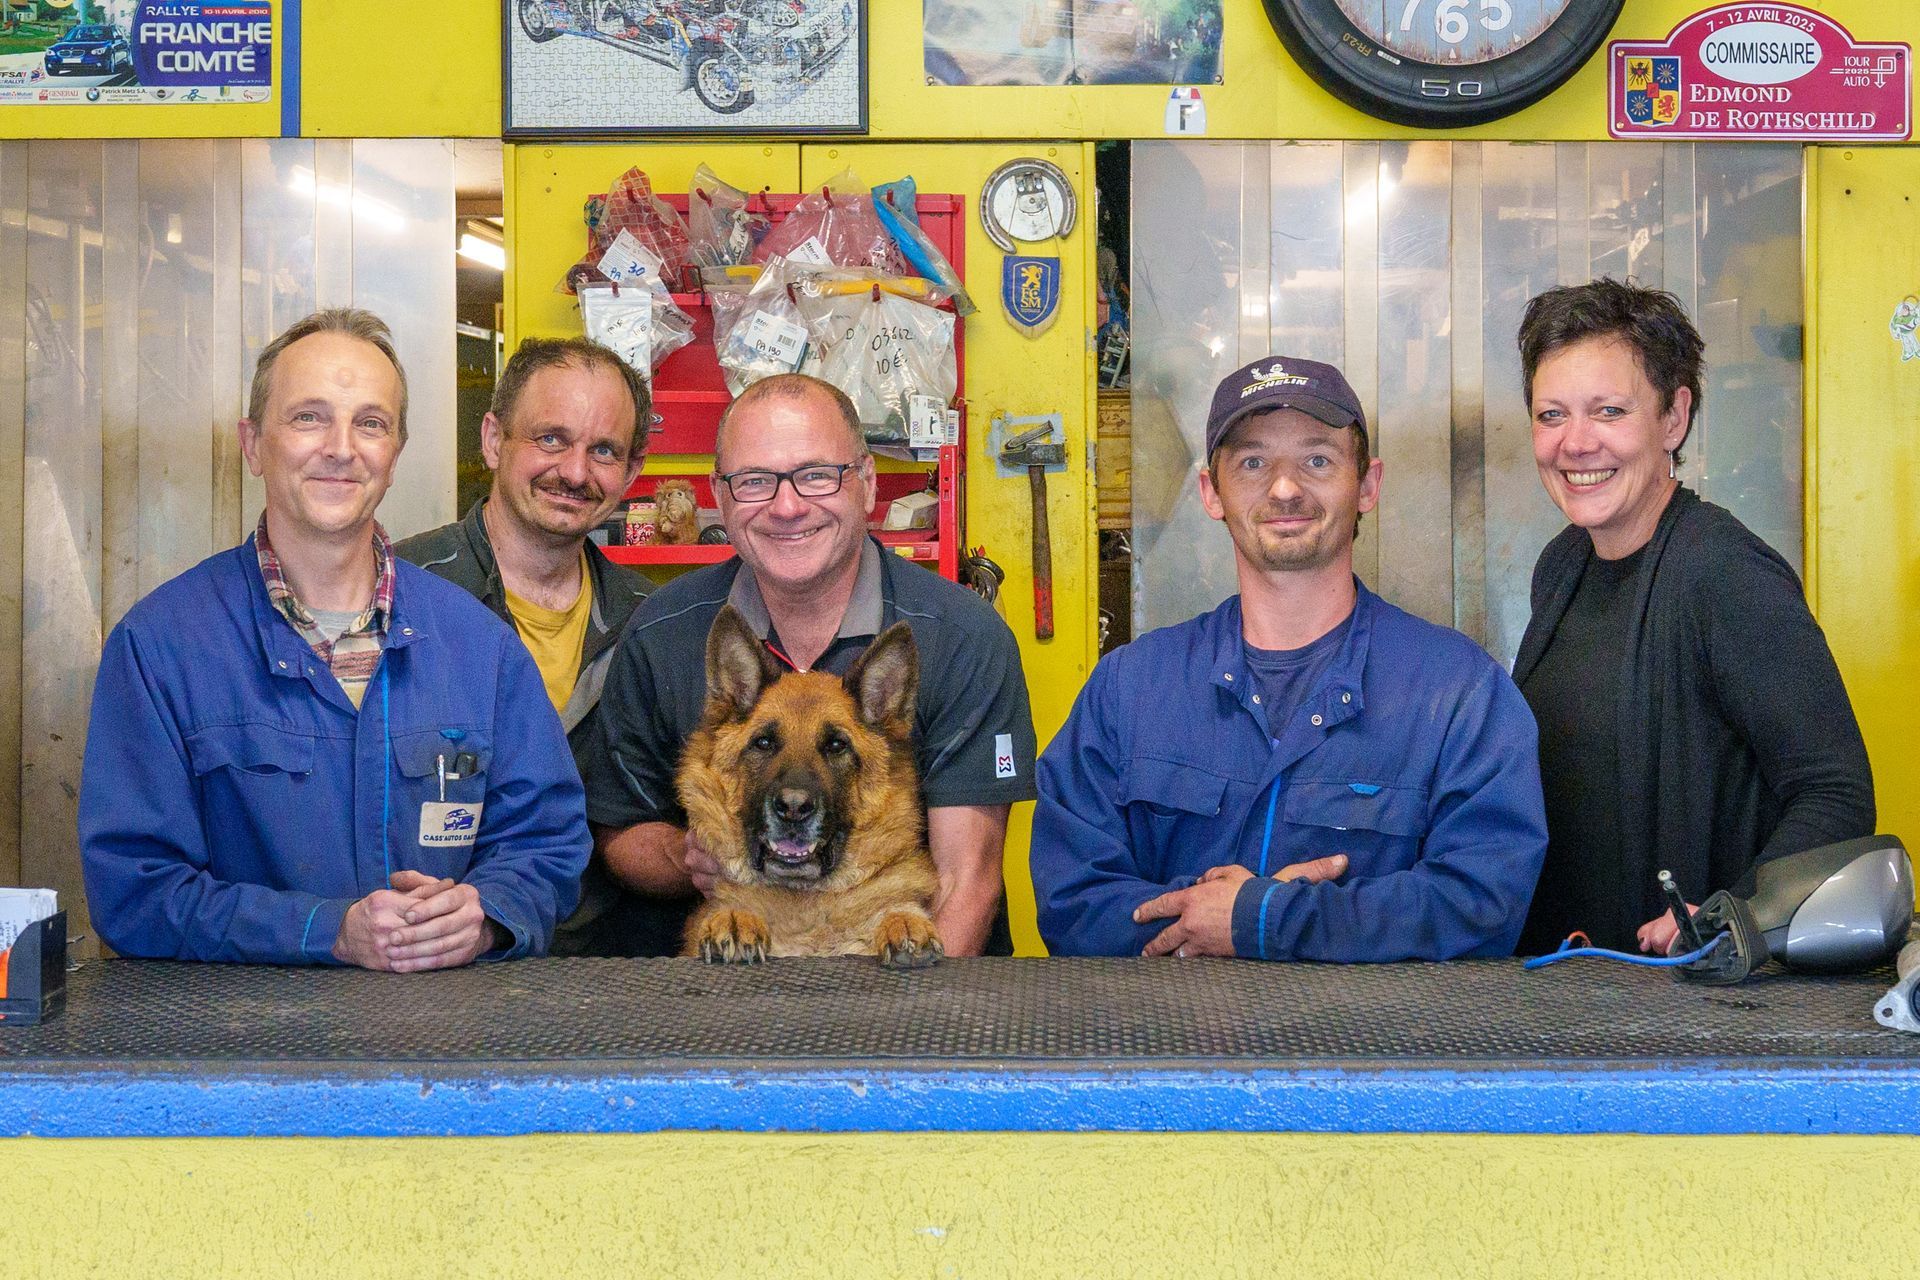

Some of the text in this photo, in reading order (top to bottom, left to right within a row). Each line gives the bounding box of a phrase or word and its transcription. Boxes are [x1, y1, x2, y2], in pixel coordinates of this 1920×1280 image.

[146, 6, 199, 16] RALLYE
[1706, 20, 1715, 32] 7
[1727, 11, 1743, 24] 12
[1747, 9, 1780, 21] AVRIL
[1784, 12, 1816, 33] 2025
[140, 22, 271, 44] FRANCHE
[157, 44, 255, 72] COMTÉ
[1706, 41, 1815, 64] COMMISSAIRE
[1844, 56, 1870, 67] TOUR
[1843, 76, 1870, 87] AUTO
[1690, 84, 1791, 104] EDMOND
[1690, 109, 1877, 130] DE ROTHSCHILD
[628, 261, 646, 277] 30
[1021, 299, 1041, 308] SM
[1240, 377, 1309, 399] MICHELIN
